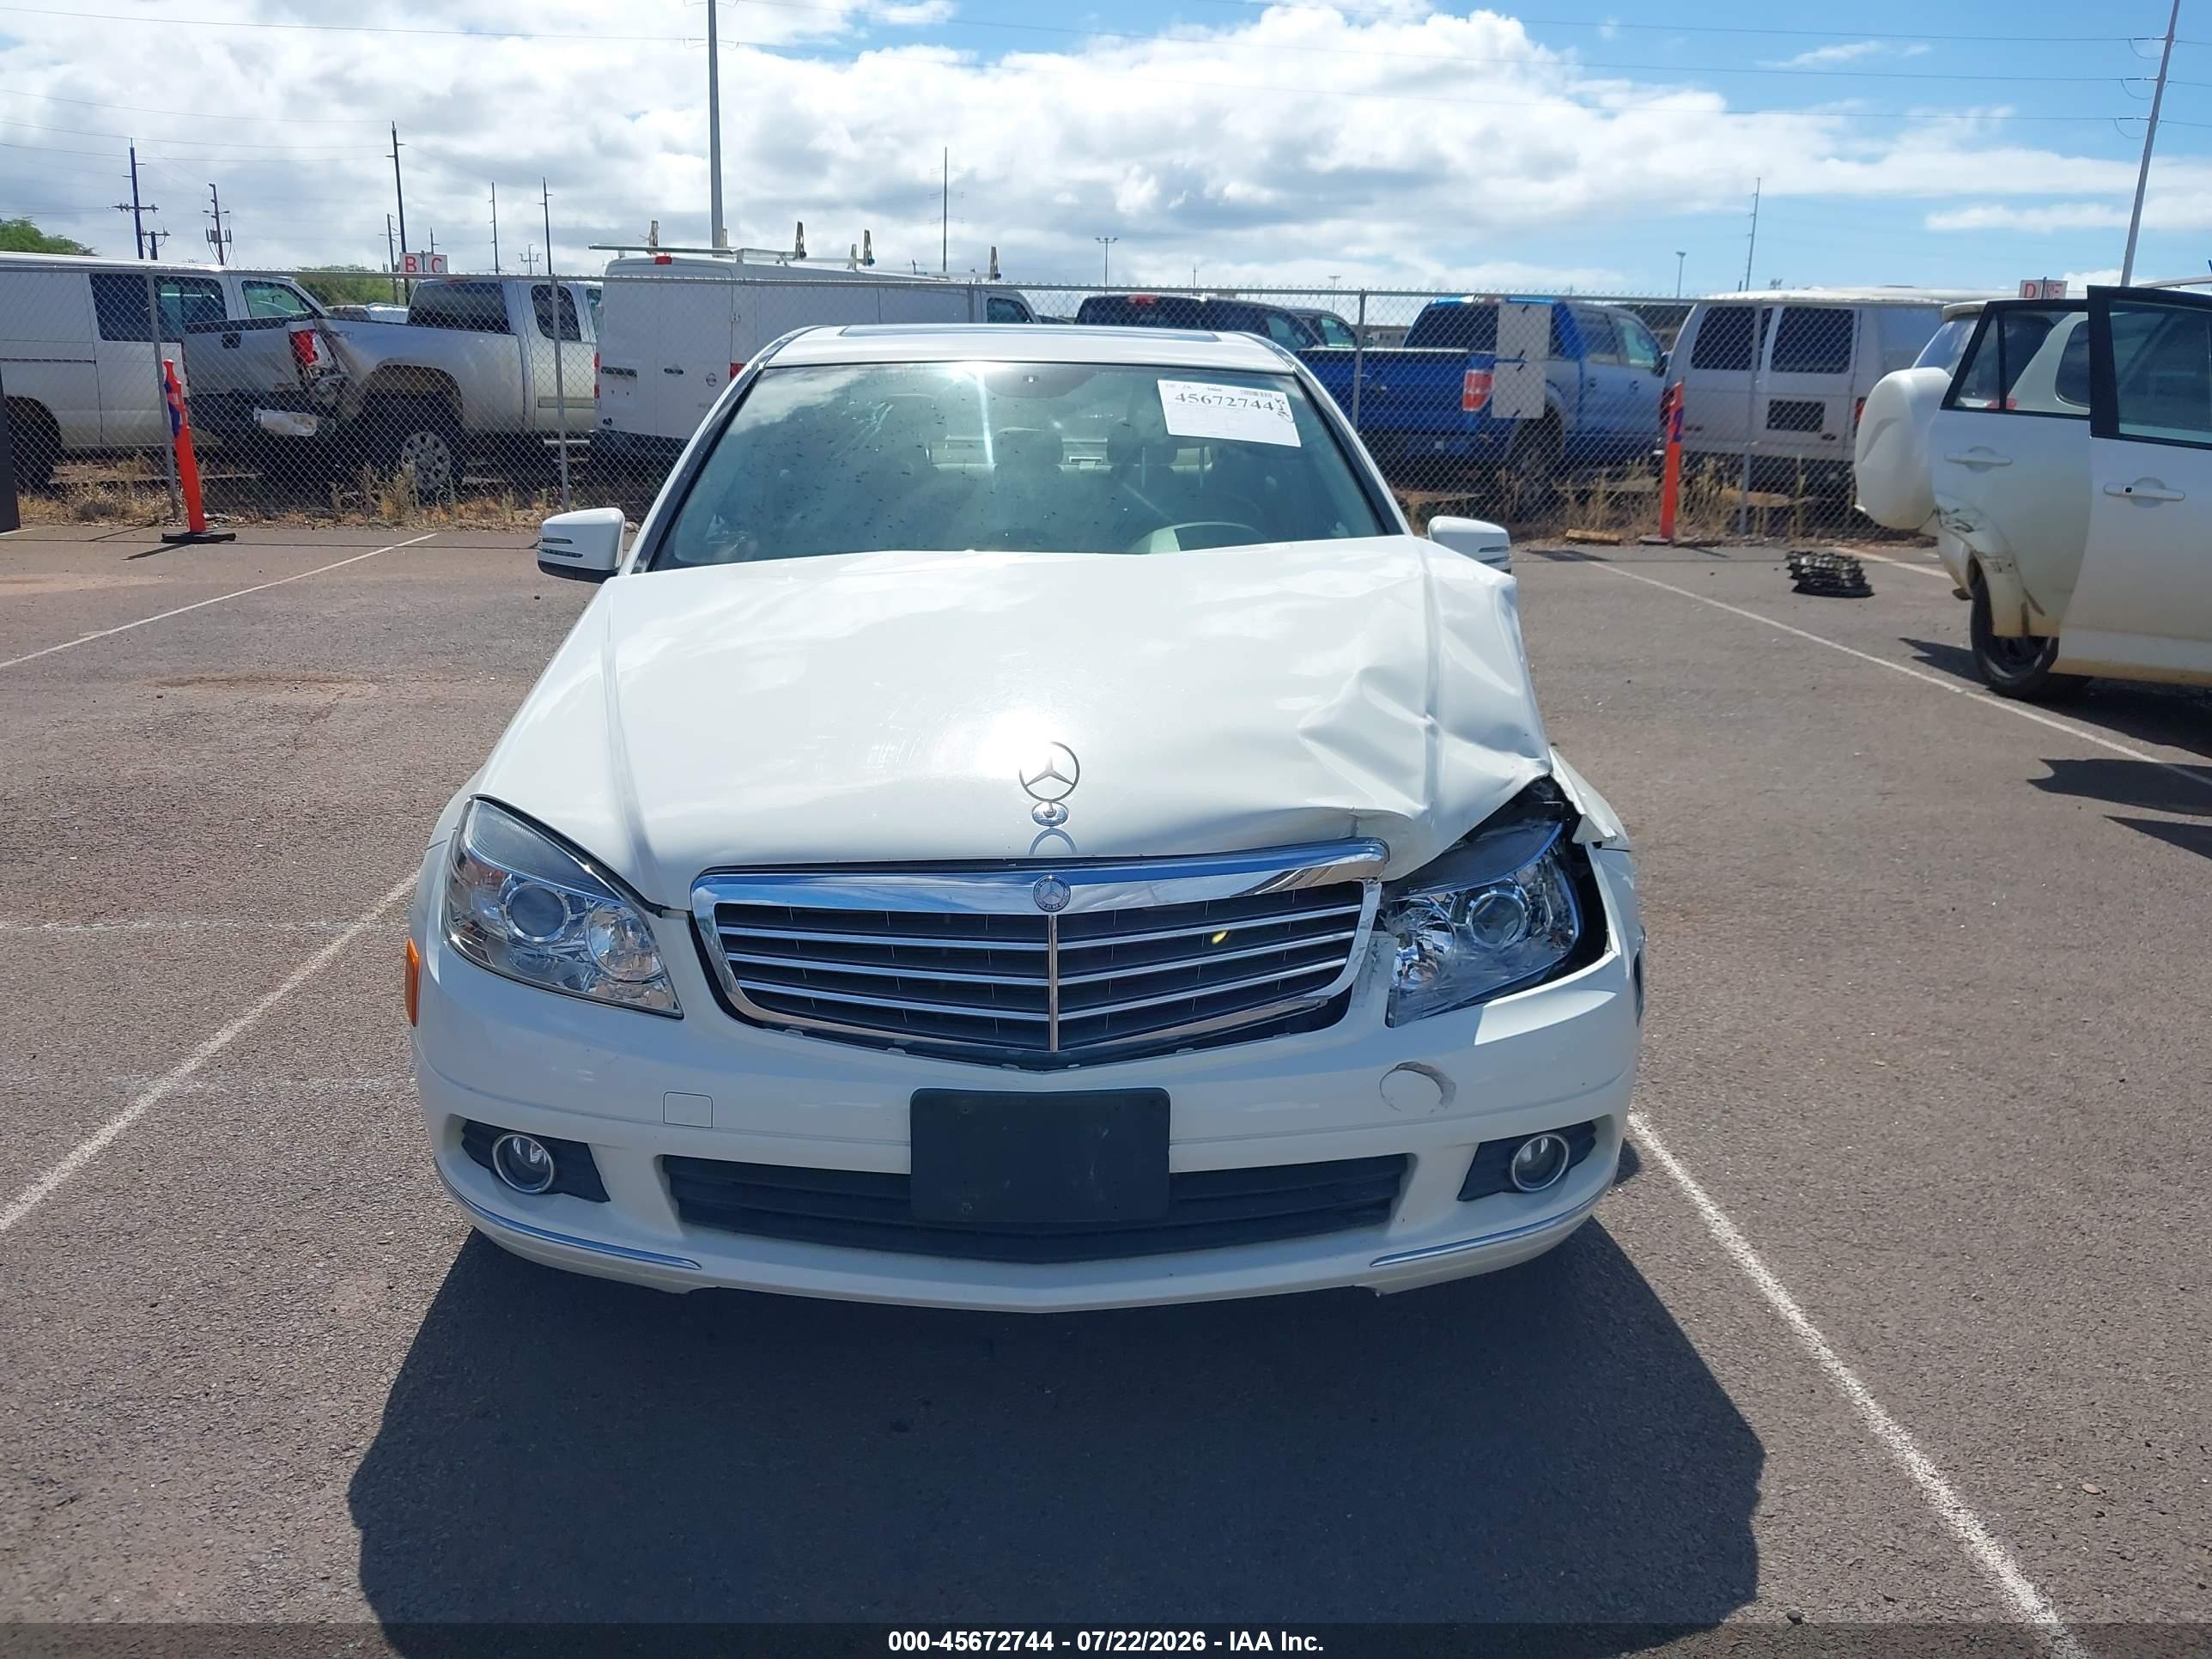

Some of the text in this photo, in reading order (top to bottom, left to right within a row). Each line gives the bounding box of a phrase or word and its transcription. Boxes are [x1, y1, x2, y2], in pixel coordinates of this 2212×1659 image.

[405, 256, 416, 273] B
[432, 257, 443, 273] C
[2025, 283, 2037, 298] D
[1175, 392, 1274, 411] 45672744
